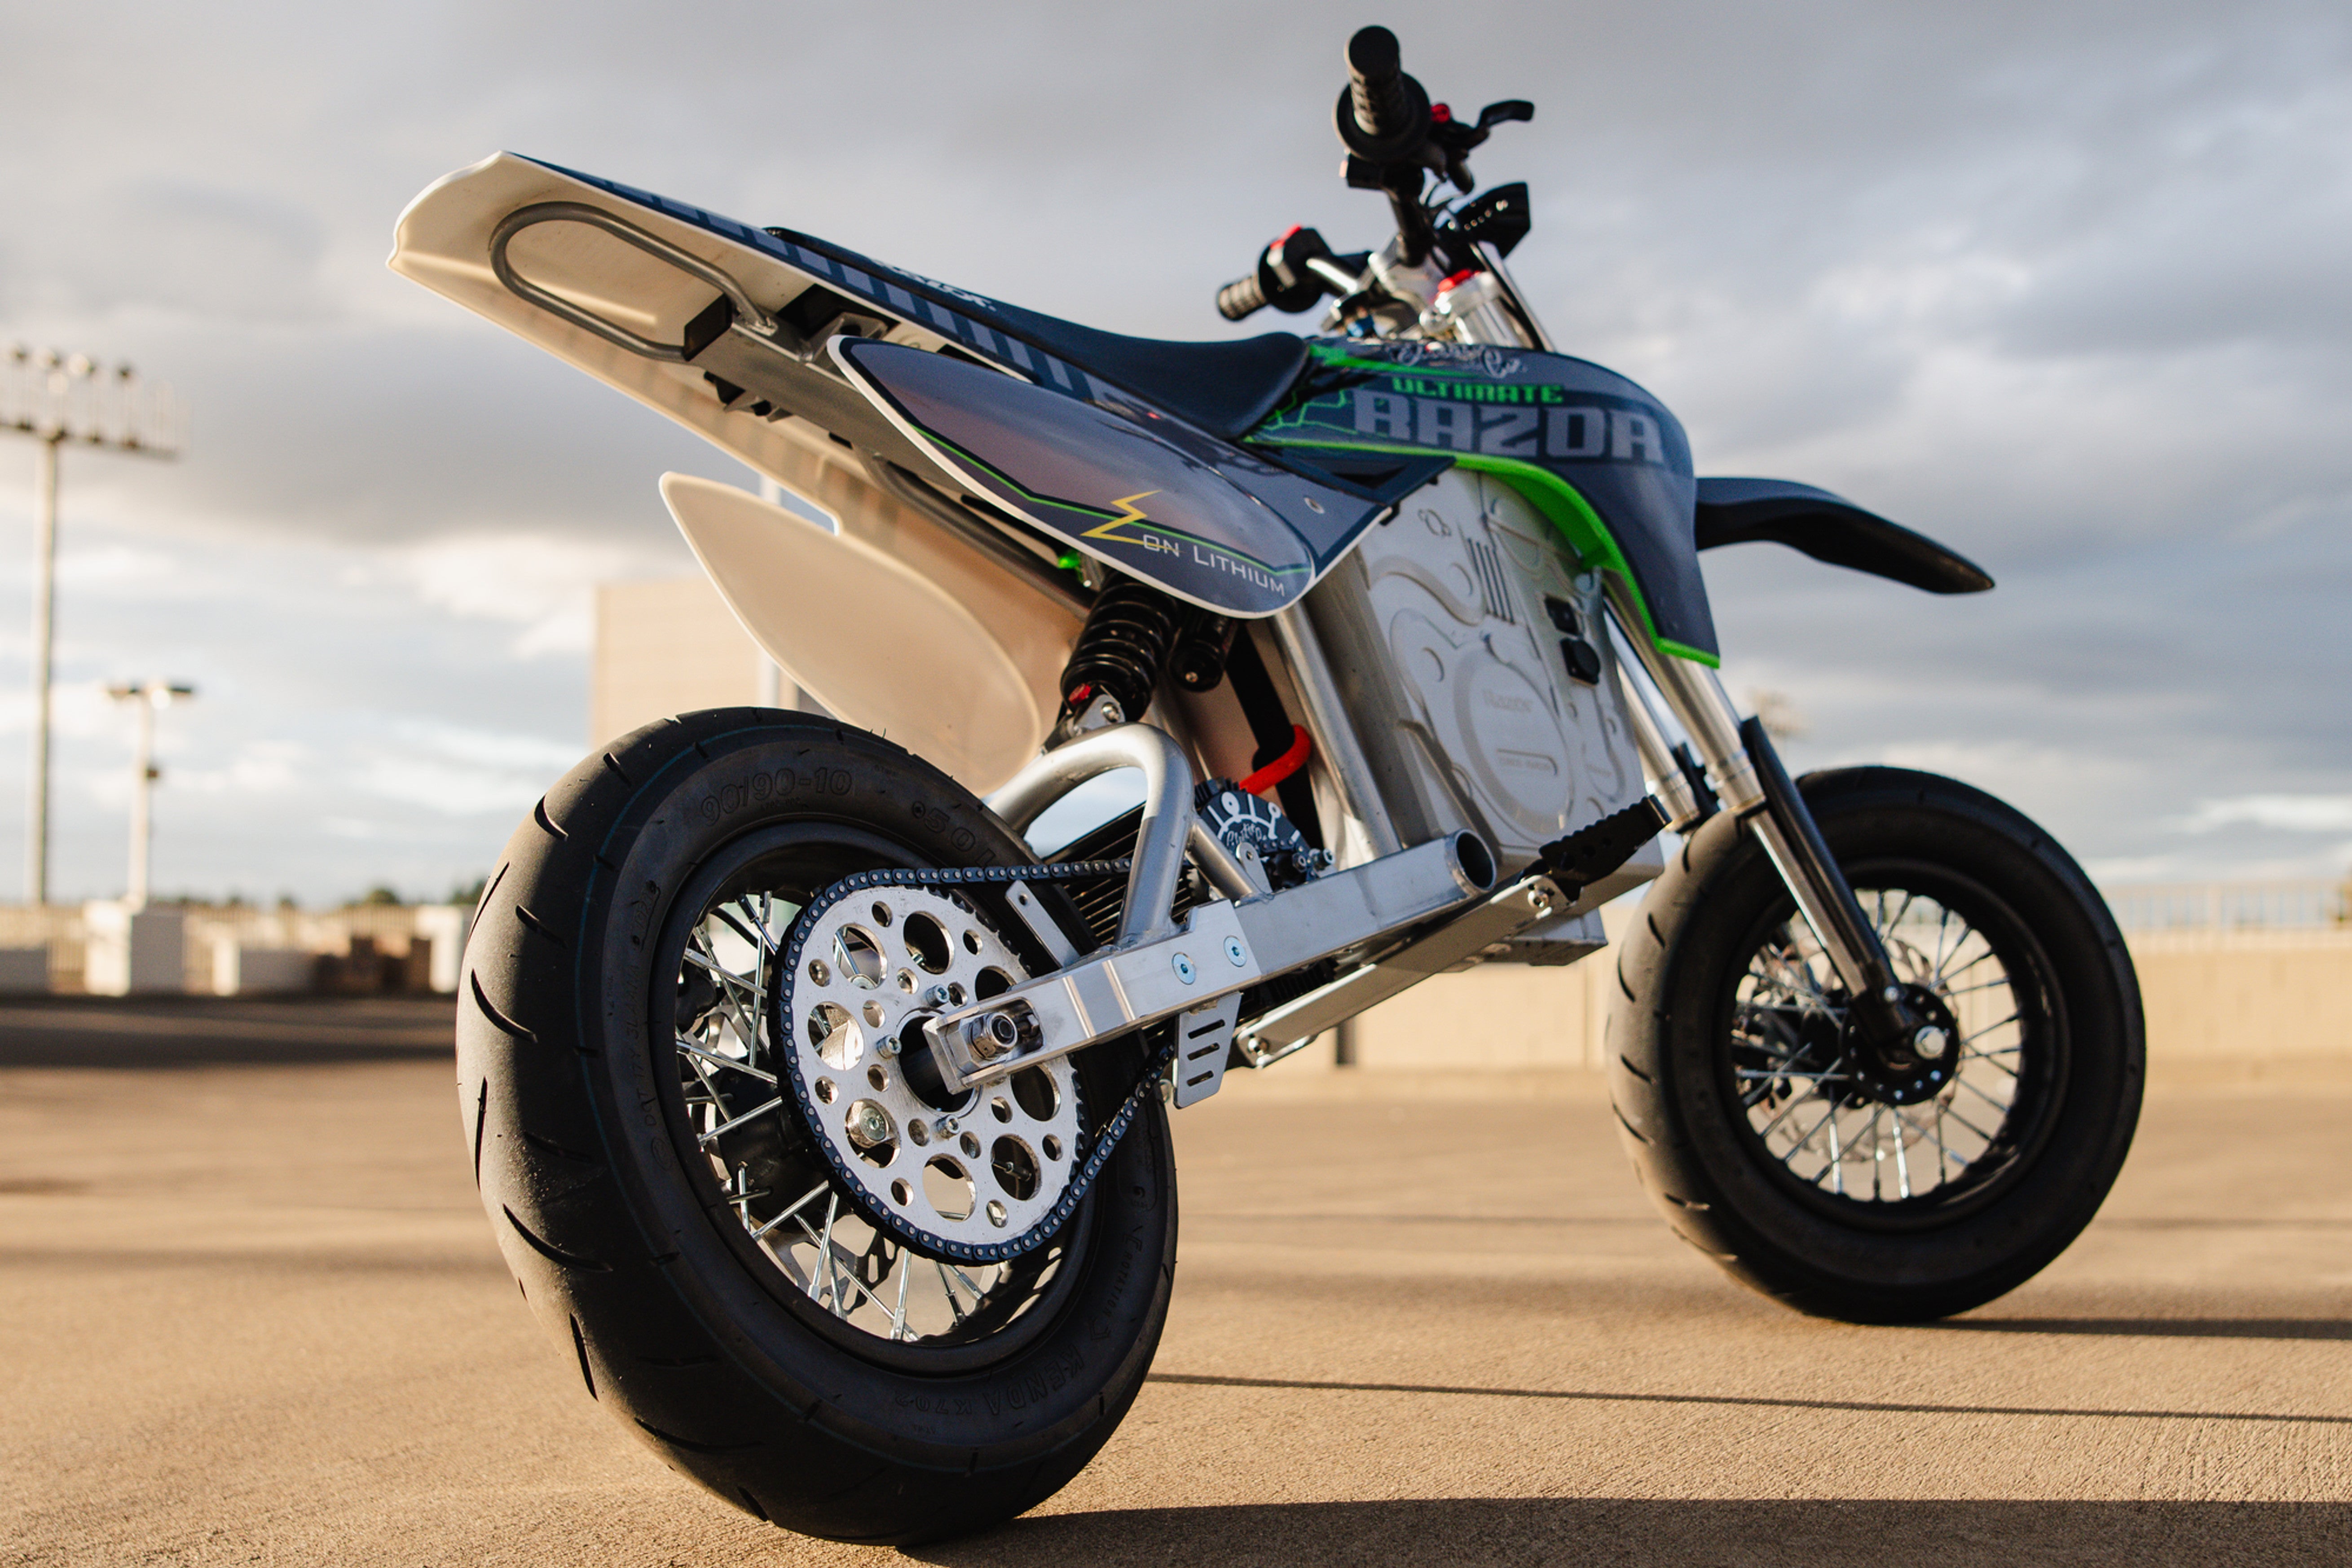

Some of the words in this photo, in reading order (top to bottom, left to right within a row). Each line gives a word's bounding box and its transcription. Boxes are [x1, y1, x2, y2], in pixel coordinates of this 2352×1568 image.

[1392, 376, 1564, 403] ULTIMATE
[1353, 388, 1664, 464] RAZOR
[701, 766, 852, 826] 90/90-10
[1102, 1251, 1133, 1317] ROTATION
[895, 1394, 973, 1415] K702
[982, 1344, 1085, 1416] KENDA
